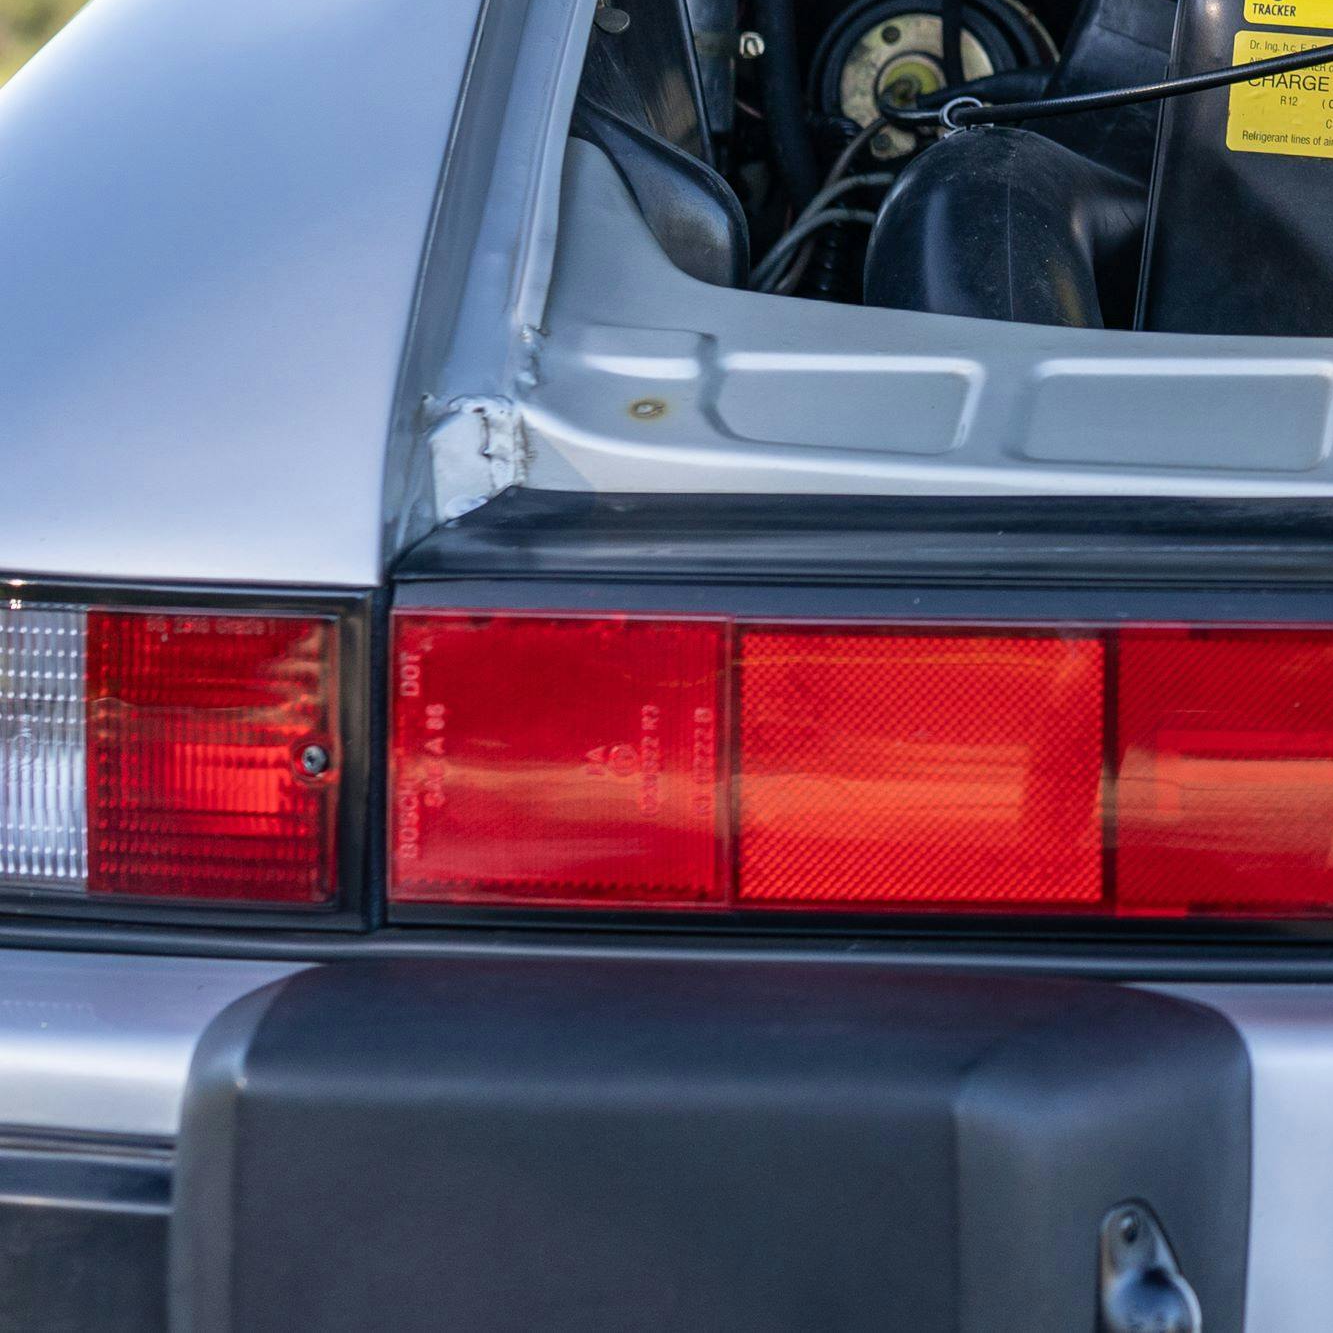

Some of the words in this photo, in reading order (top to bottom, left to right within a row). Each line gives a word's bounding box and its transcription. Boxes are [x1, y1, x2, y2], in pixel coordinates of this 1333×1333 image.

[1252, 3, 1297, 17] TRACKER
[1249, 39, 1262, 50] Dr.
[1264, 41, 1280, 53] Ing.
[1248, 72, 1330, 93] CHARGE
[1242, 130, 1288, 144] Refrigerant
[1290, 134, 1311, 145] lines
[1313, 136, 1322, 146] of
[399, 652, 421, 697] DOT
